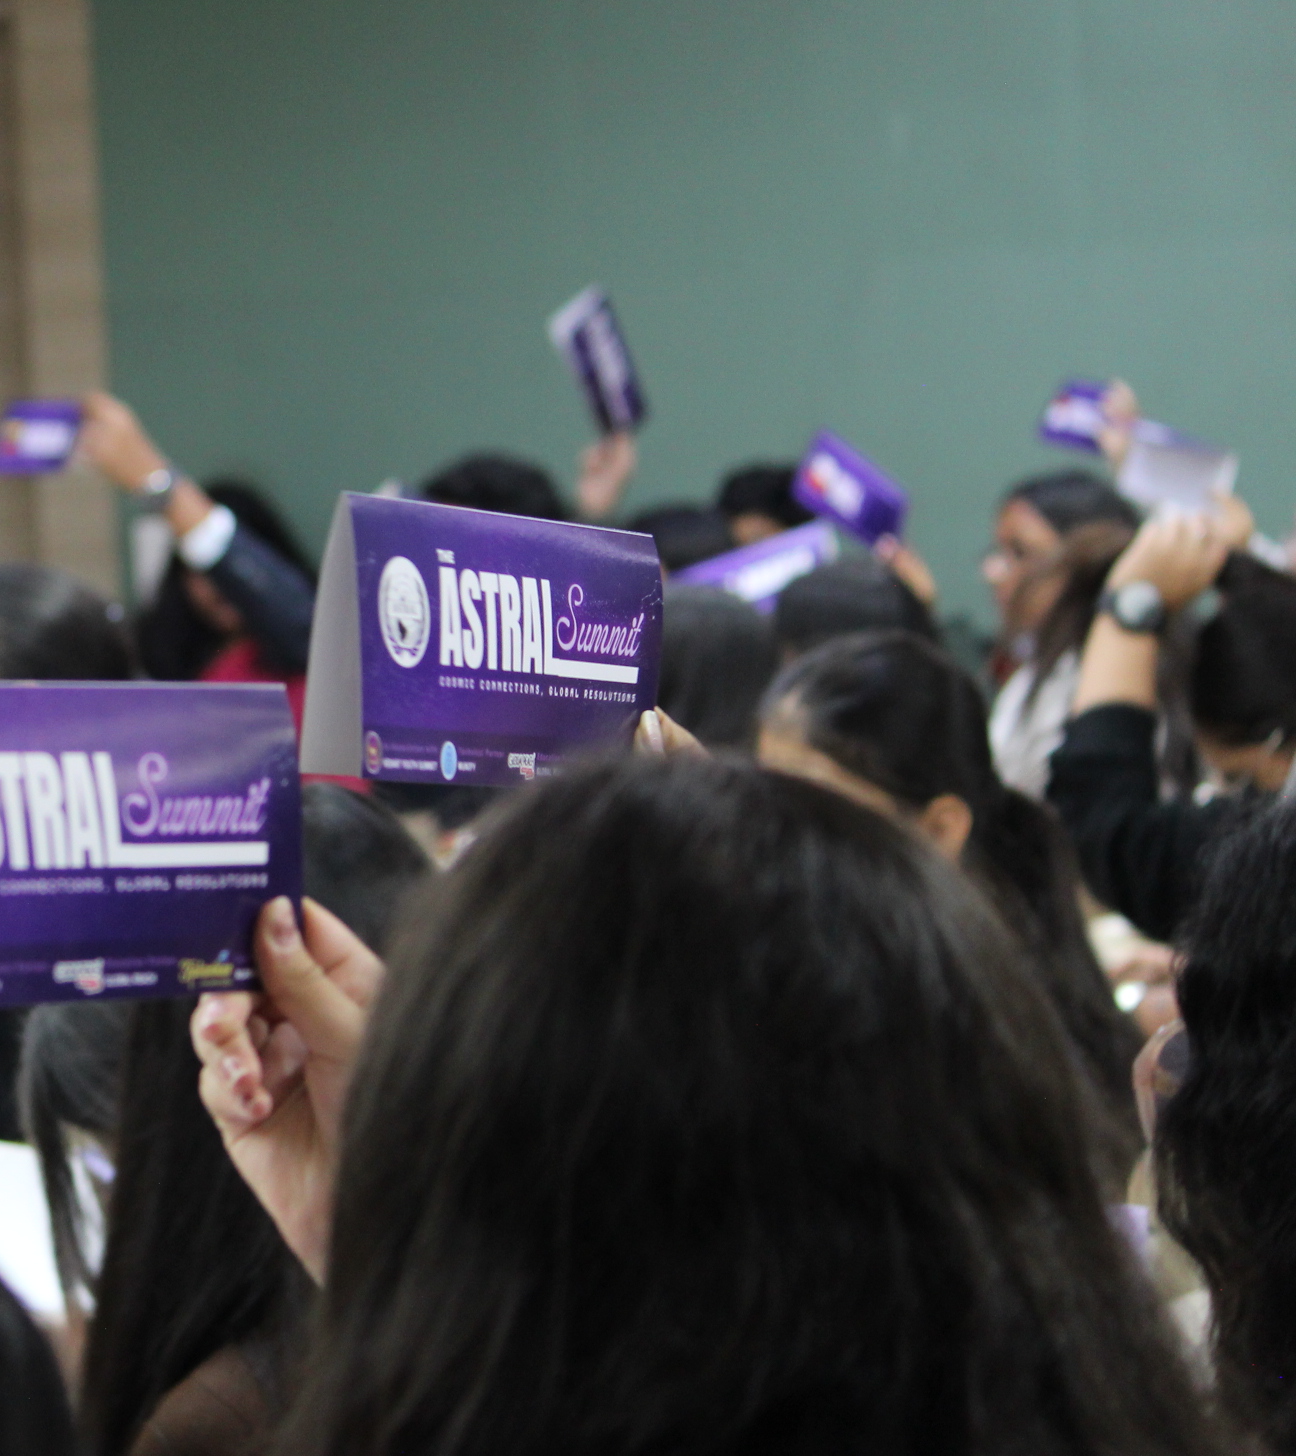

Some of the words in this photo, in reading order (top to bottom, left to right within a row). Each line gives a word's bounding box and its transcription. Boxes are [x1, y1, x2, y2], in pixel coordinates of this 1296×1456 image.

[436, 549, 455, 564] THE
[556, 584, 644, 657] Summit
[439, 676, 475, 690] COSMIC
[548, 685, 579, 698] GLOBAL
[584, 689, 637, 703] RESOLUTIONS
[121, 752, 272, 837] Summit
